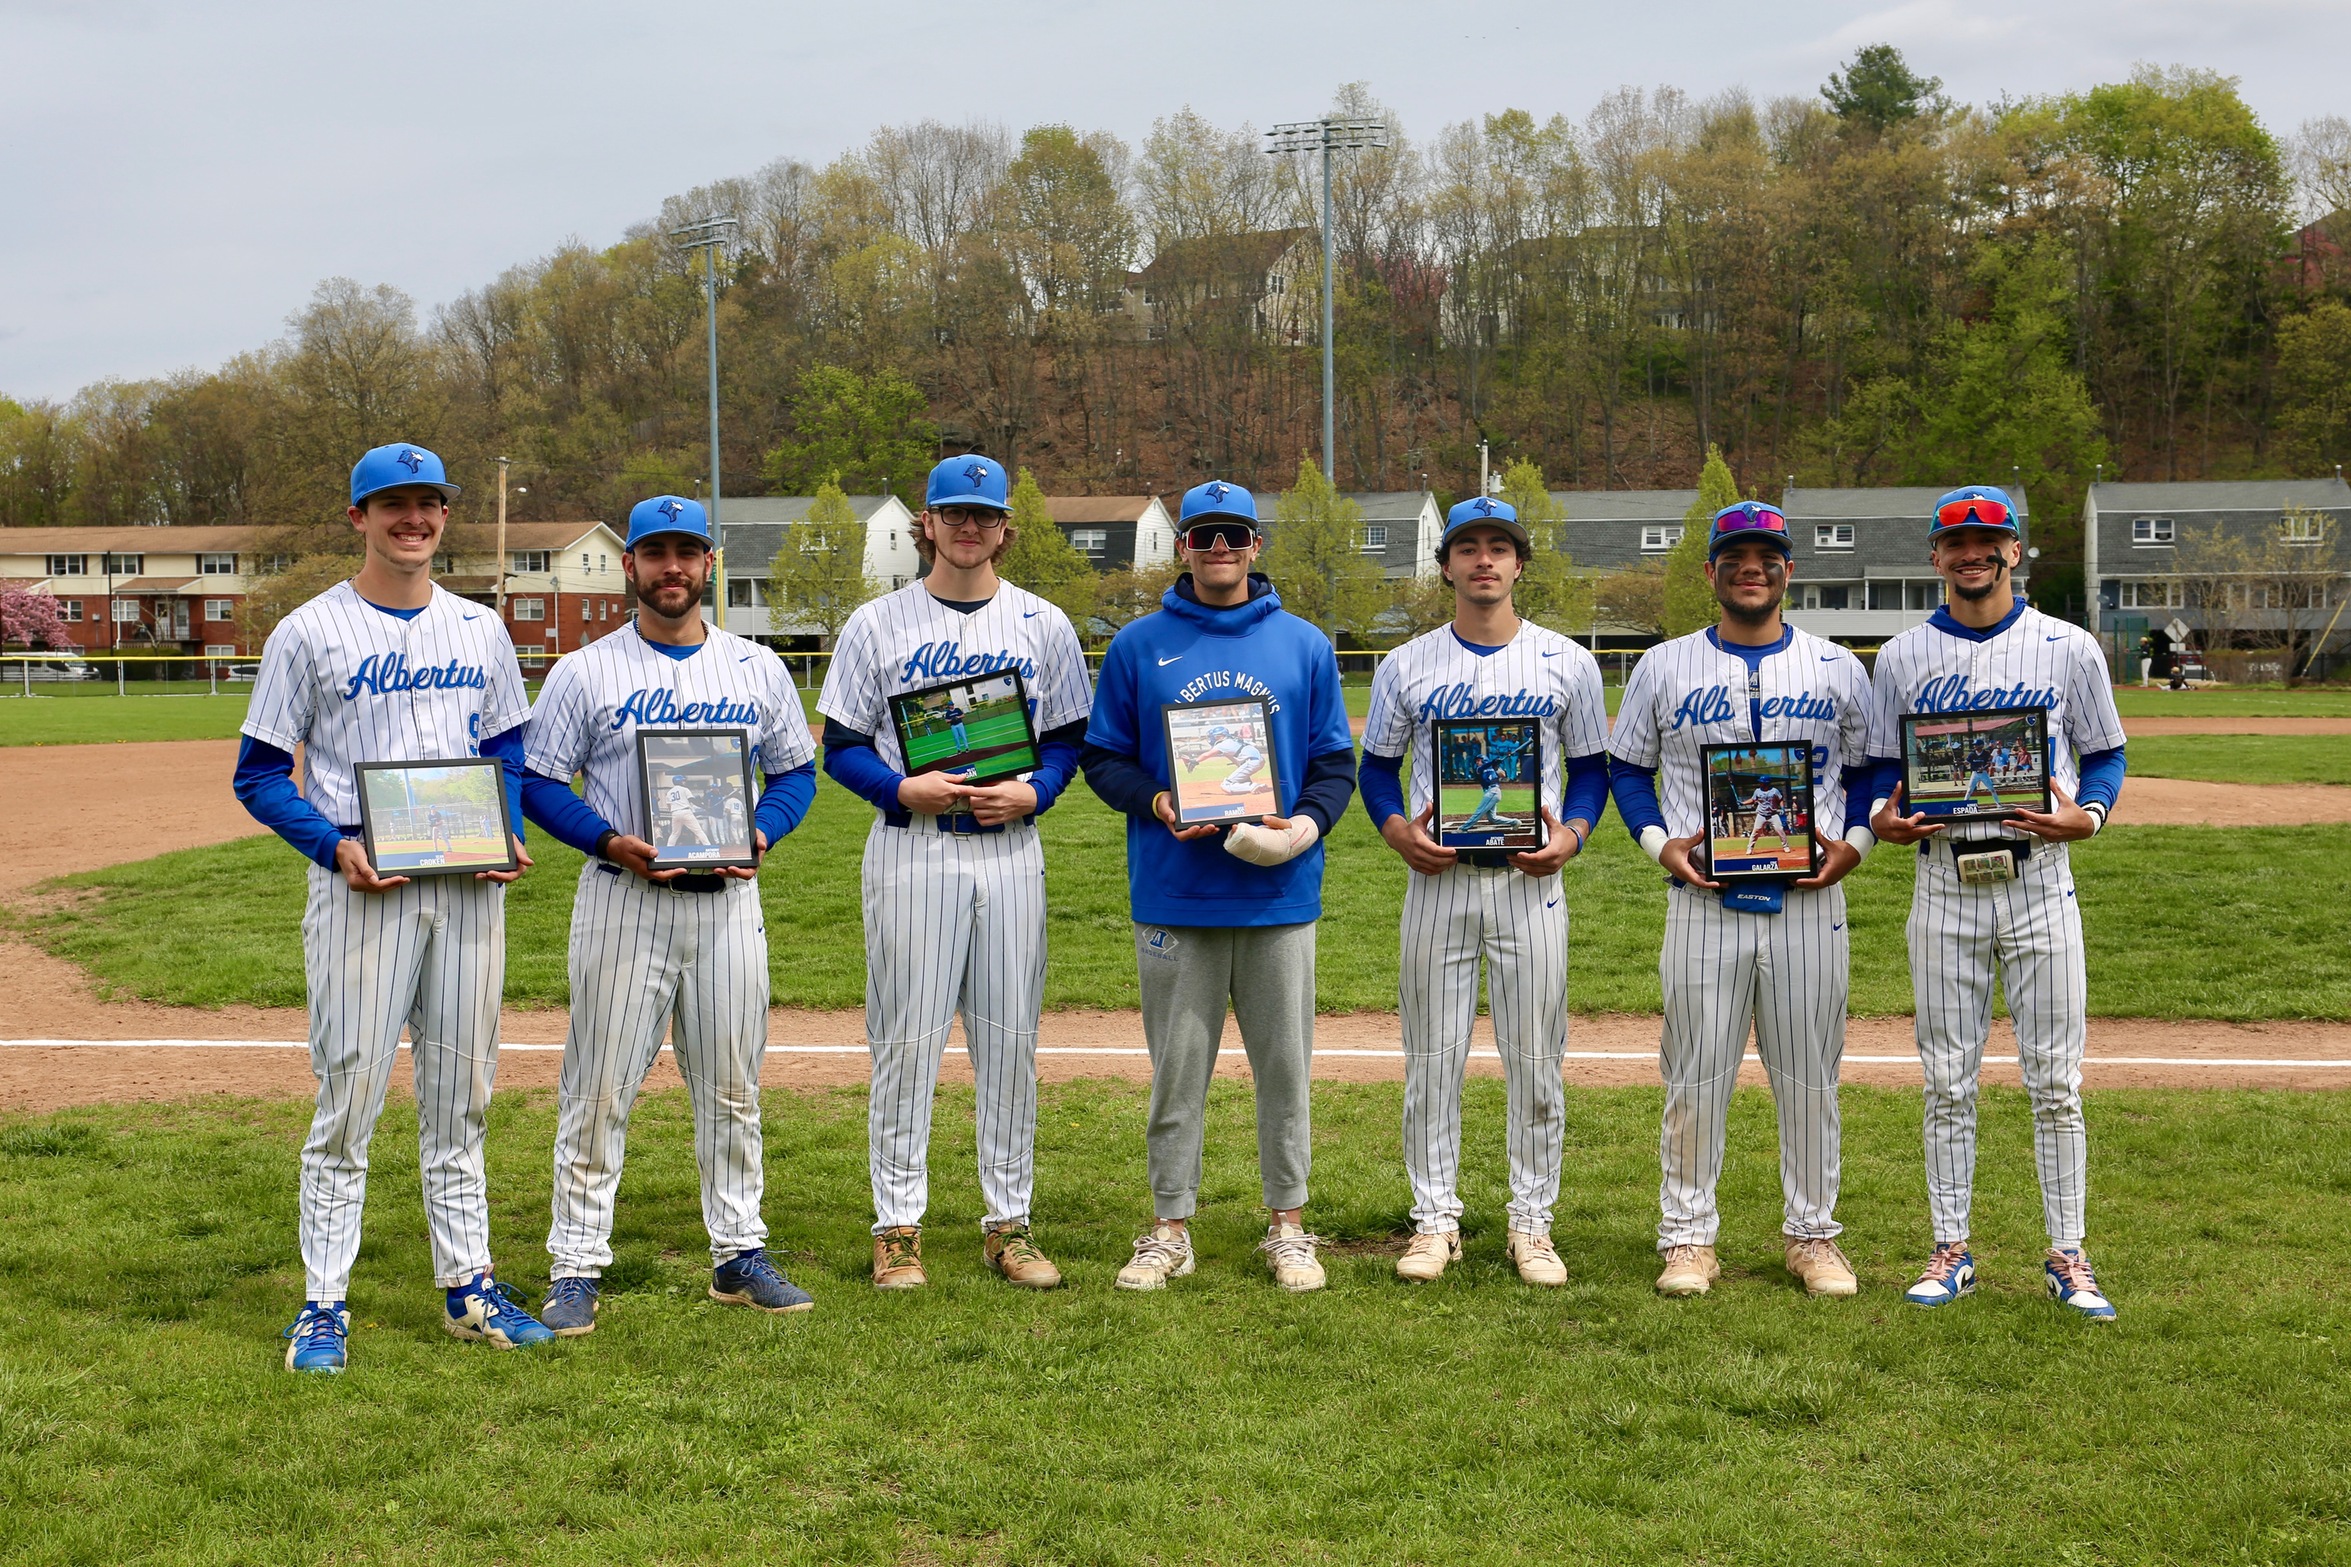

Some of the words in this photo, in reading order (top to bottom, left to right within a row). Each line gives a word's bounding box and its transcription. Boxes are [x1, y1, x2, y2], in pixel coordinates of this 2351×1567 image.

[343, 651, 488, 700] Albertus
[900, 640, 1037, 683] Albertus
[1175, 670, 1231, 704] BERTUS
[1418, 682, 1558, 724] Albertus
[1913, 673, 2059, 713] Albertus
[610, 687, 760, 730] Albertus
[1751, 863, 1779, 872] GALARZA
[1736, 893, 1771, 902] EASTON
